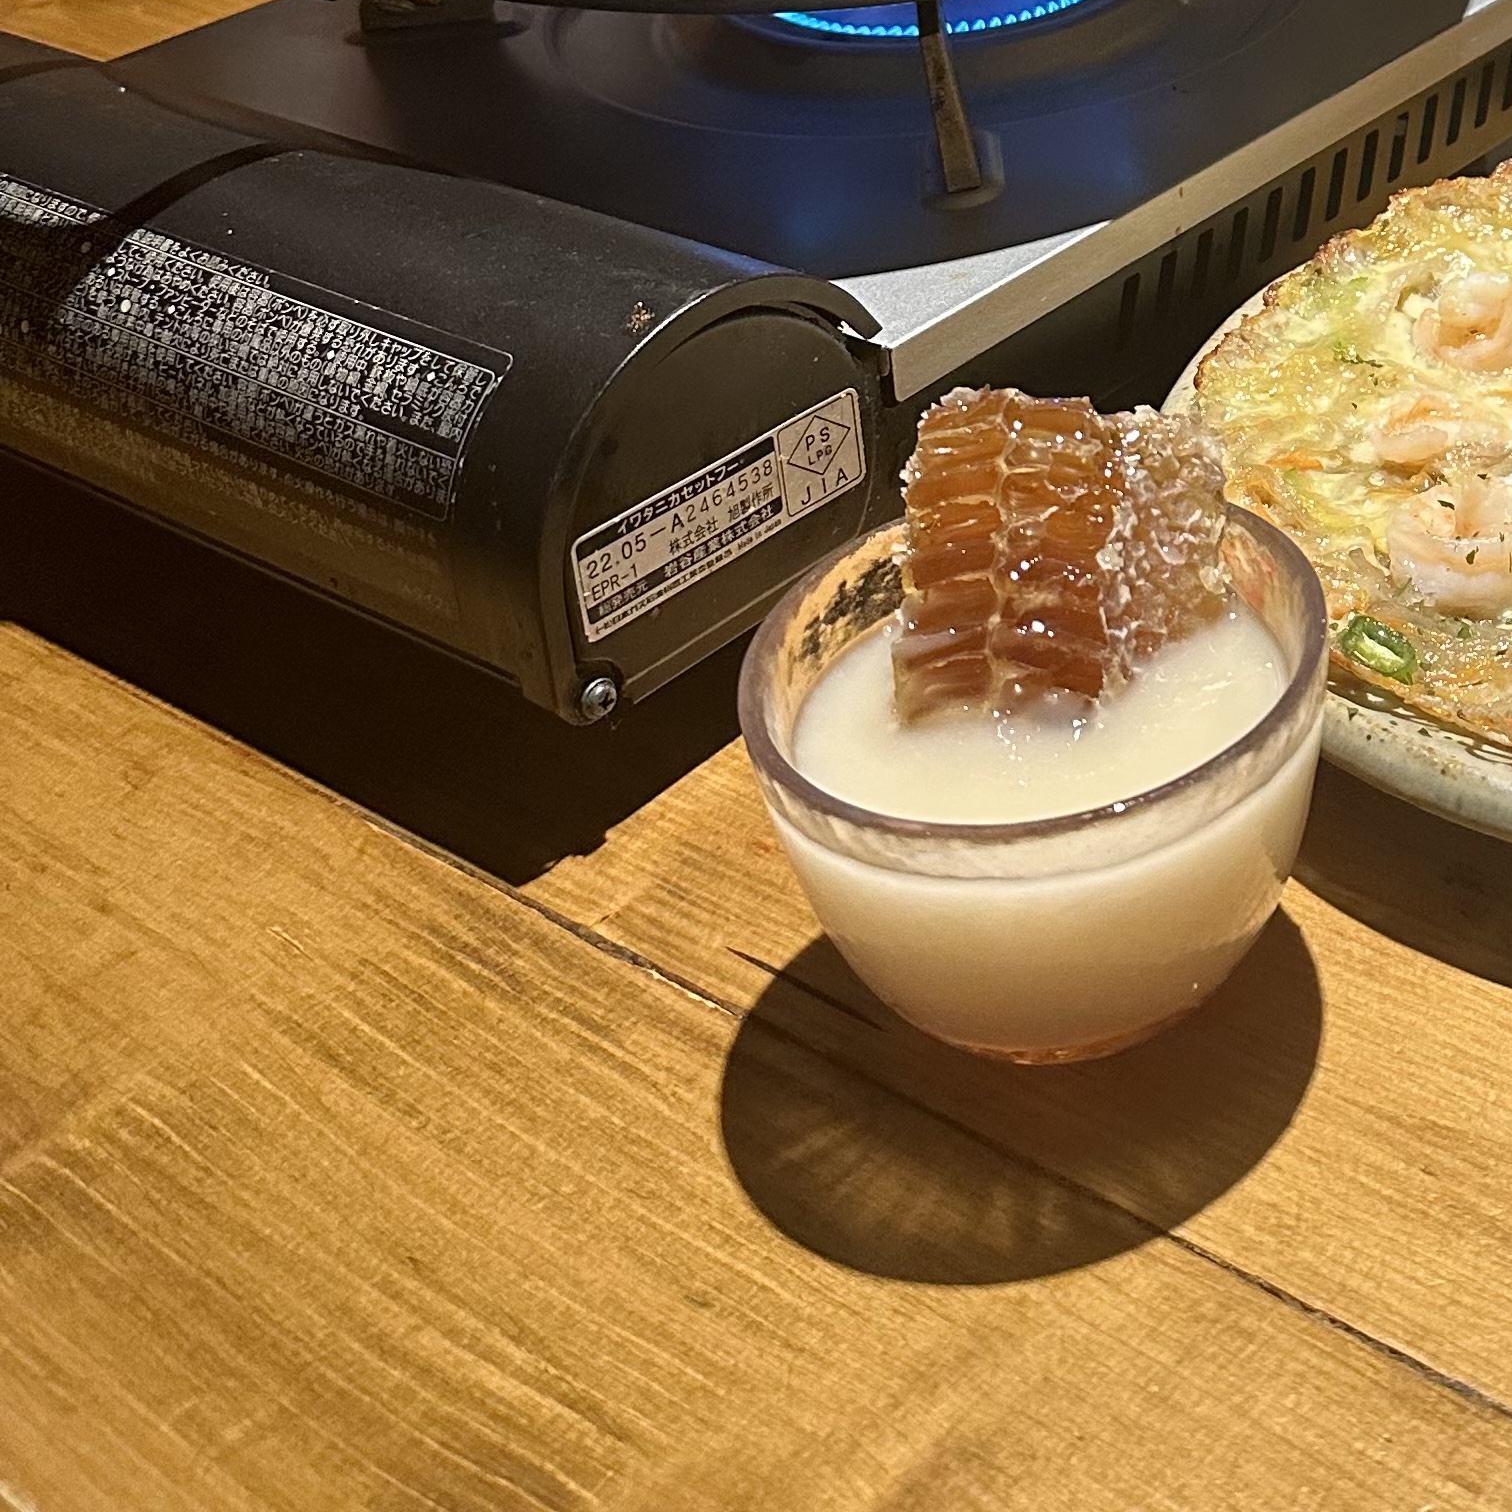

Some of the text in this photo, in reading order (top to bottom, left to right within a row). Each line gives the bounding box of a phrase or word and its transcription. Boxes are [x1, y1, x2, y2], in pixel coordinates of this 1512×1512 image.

[805, 426, 831, 451] PS
[807, 444, 834, 467] LPG
[668, 518, 719, 556] 株式会社
[591, 563, 638, 602] EPR-1
